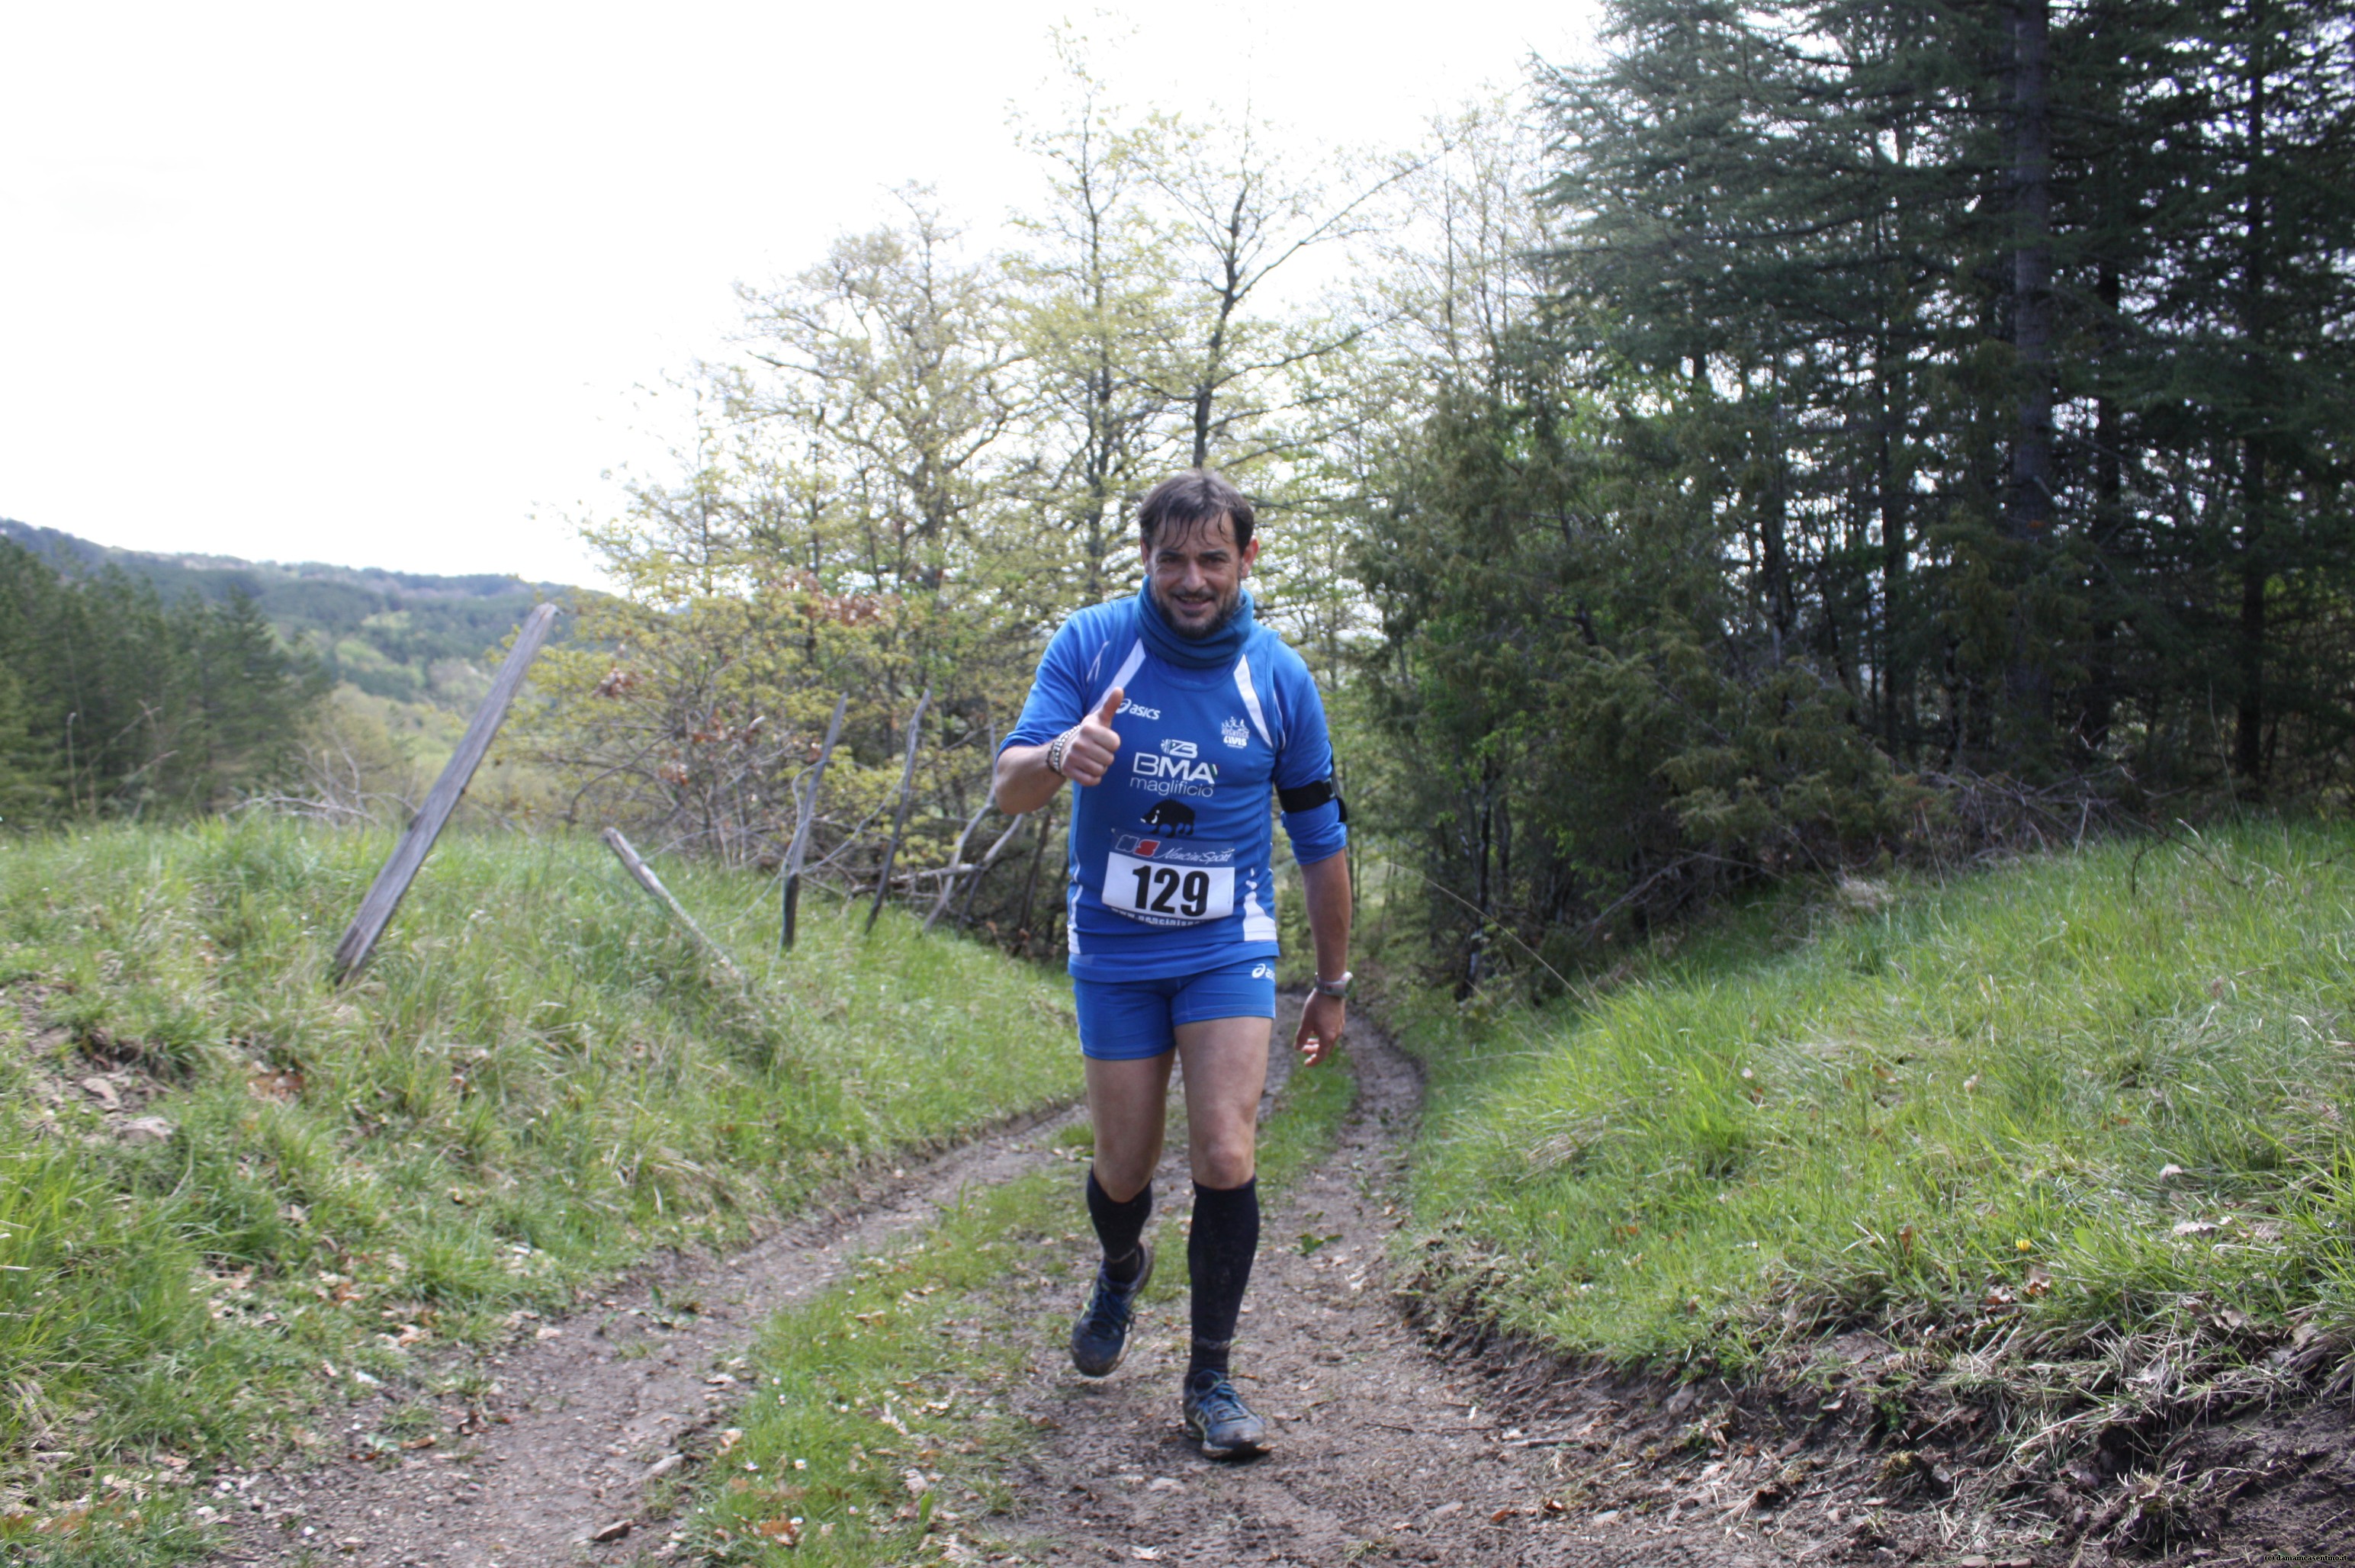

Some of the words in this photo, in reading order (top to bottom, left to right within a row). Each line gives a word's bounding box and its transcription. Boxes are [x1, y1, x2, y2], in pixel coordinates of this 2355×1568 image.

[1129, 703, 1161, 721] asics
[1133, 752, 1216, 785] BMA
[1129, 776, 1214, 798] maglificio
[1153, 847, 1200, 862] Nencini
[1199, 848, 1235, 865] Sport
[1133, 865, 1210, 917] 129
